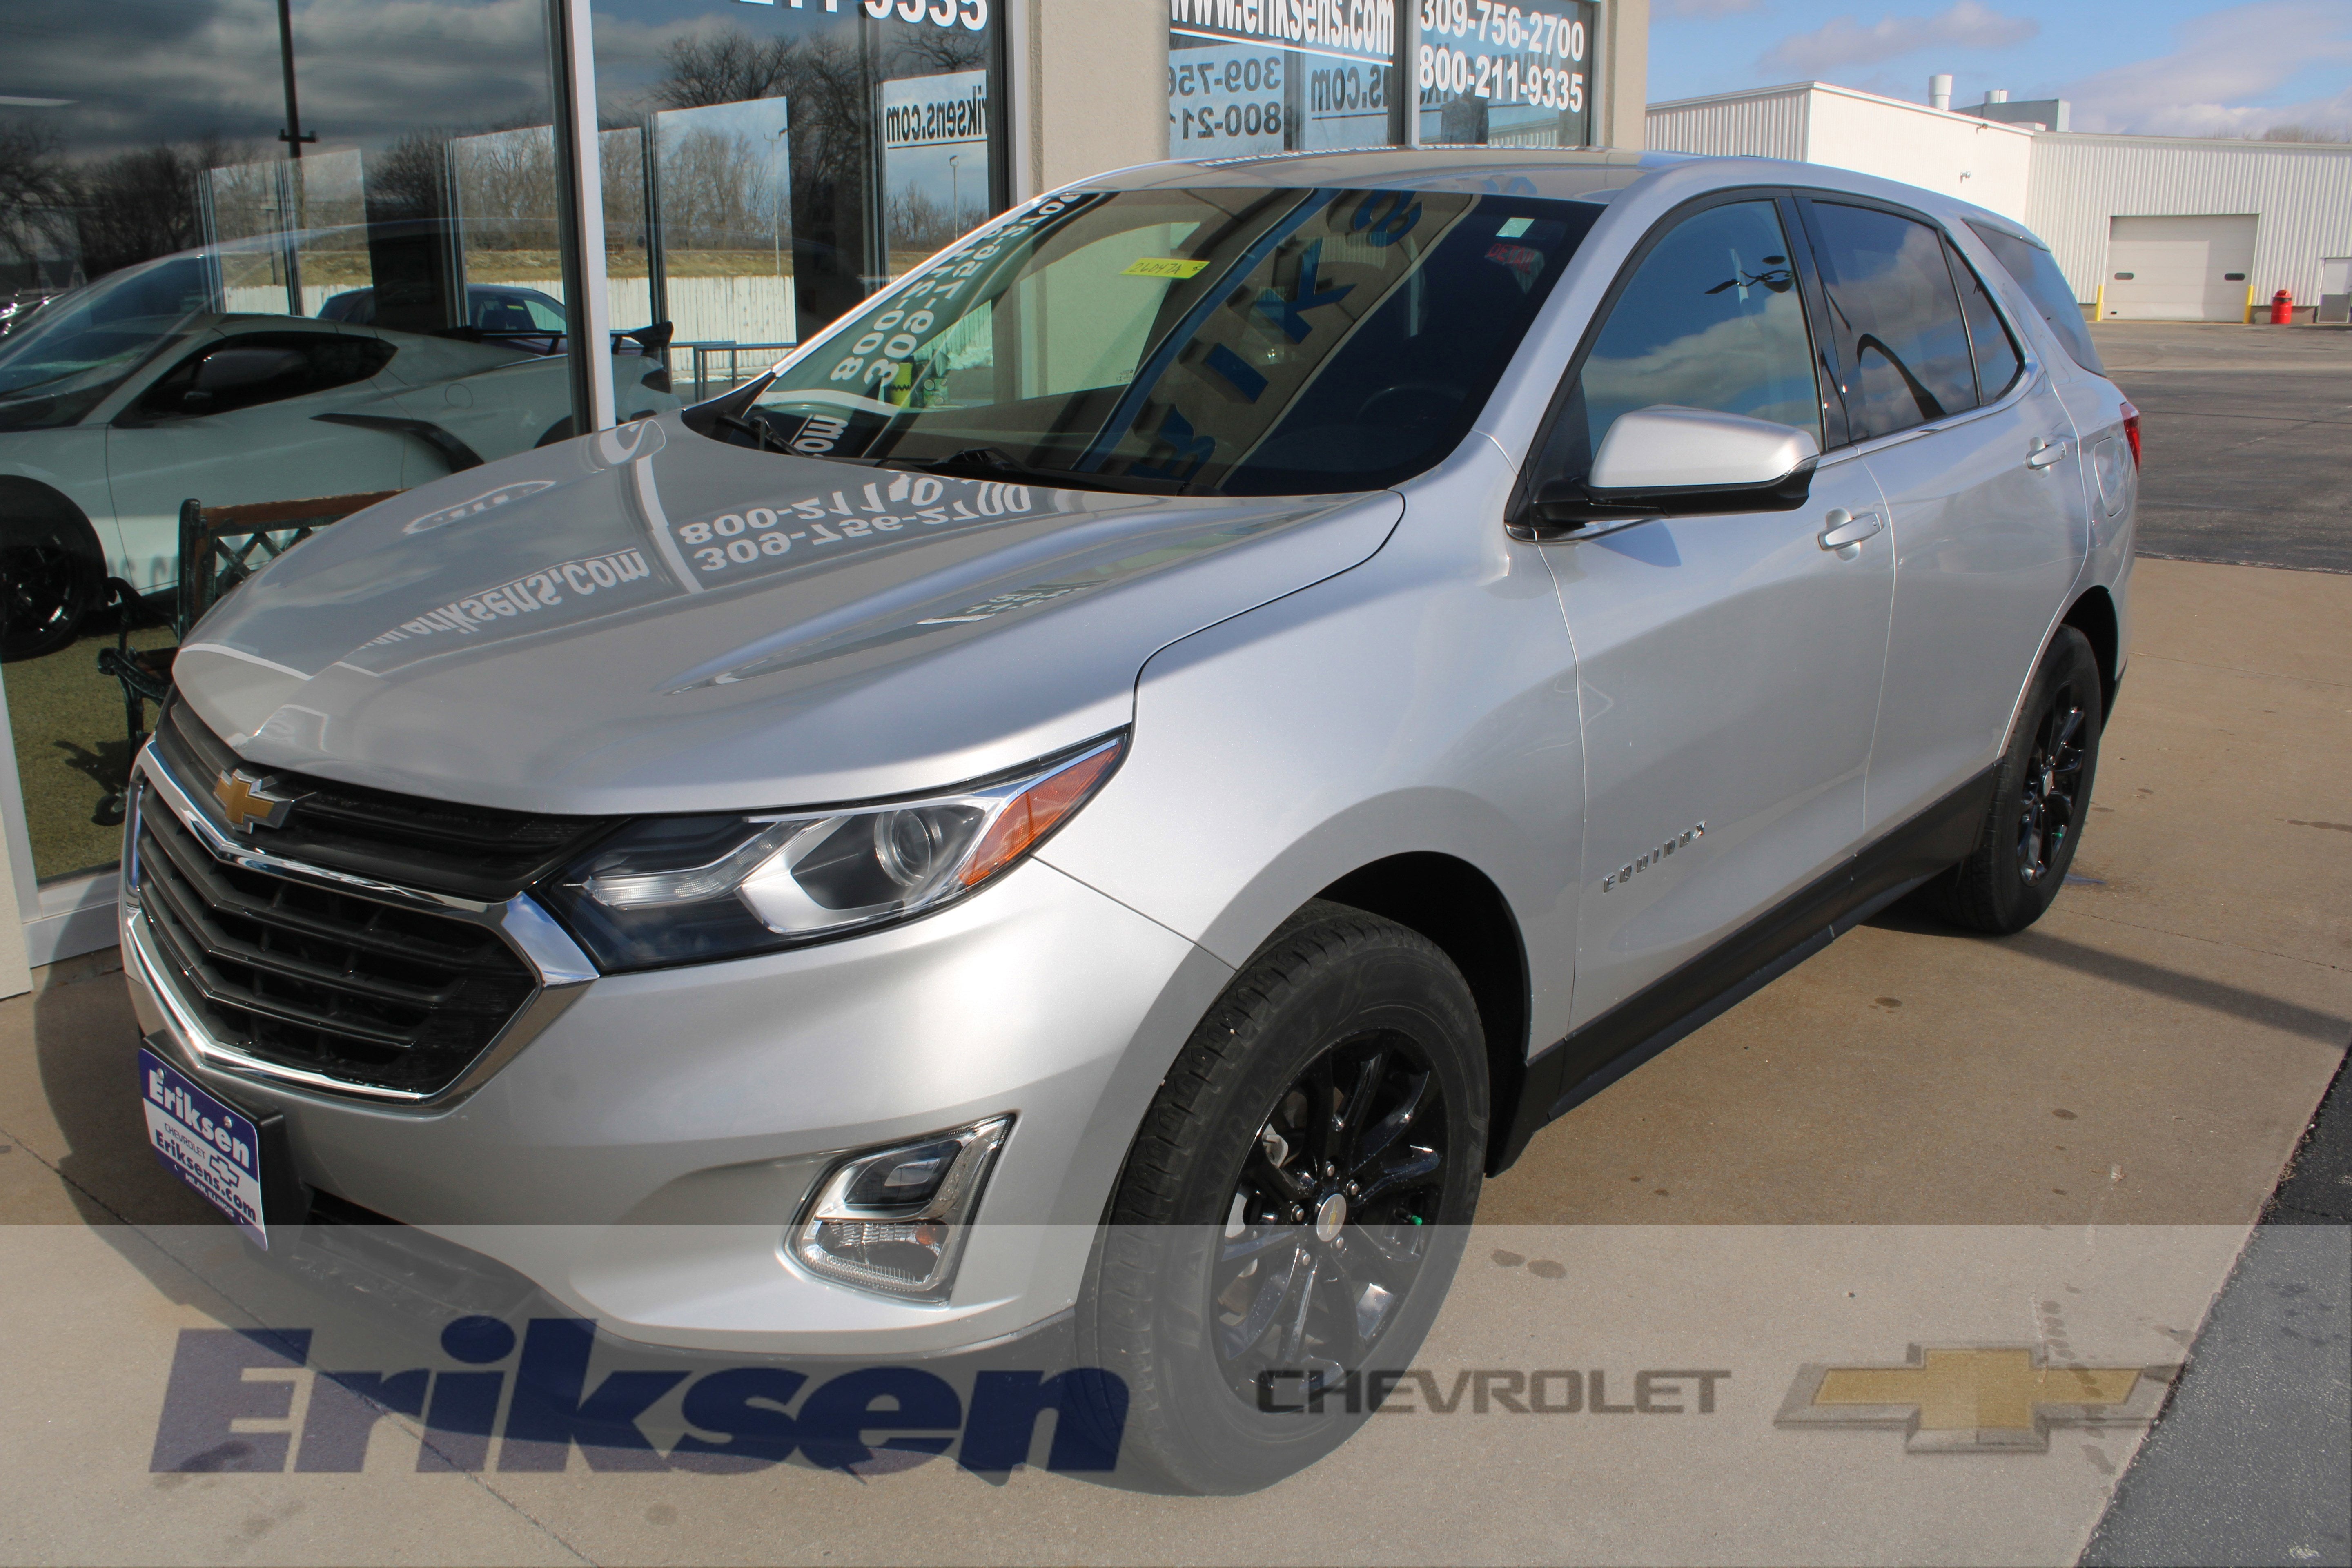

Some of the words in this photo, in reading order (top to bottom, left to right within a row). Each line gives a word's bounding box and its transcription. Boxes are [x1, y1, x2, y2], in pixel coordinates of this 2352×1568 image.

[1421, 0, 1584, 62] 309-756-2700
[1420, 44, 1583, 113] 800-211-9335
[1487, 243, 1535, 275] DETAIL
[1603, 820, 1707, 893] EQUINOX
[149, 1069, 250, 1168] Eriksen
[165, 1123, 206, 1160] CHEVROLET
[156, 1129, 256, 1223] Eriksens.com
[208, 1192, 234, 1218] ILLINOIS
